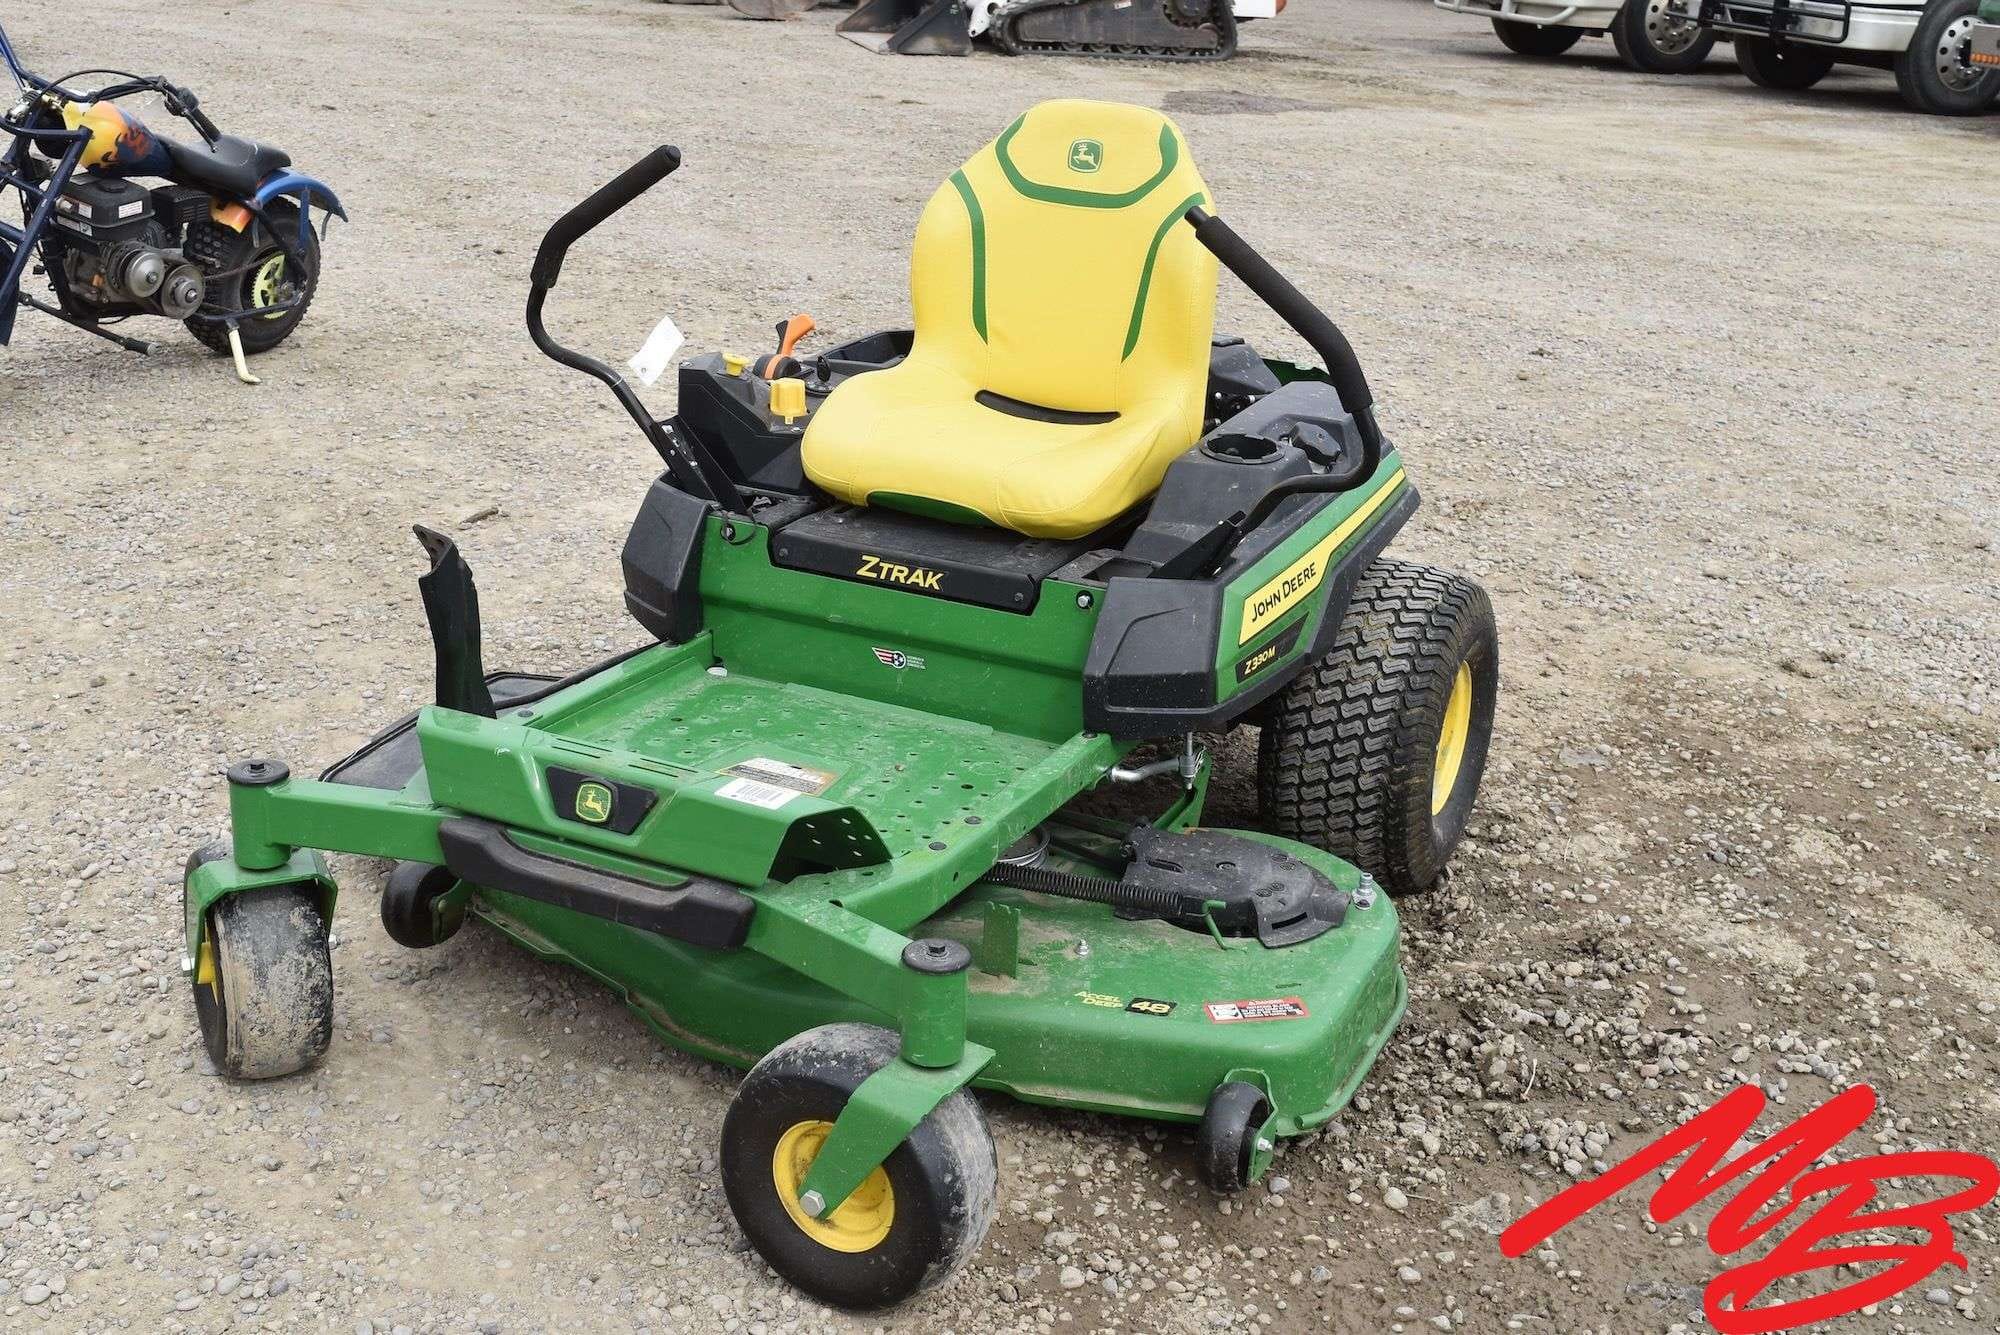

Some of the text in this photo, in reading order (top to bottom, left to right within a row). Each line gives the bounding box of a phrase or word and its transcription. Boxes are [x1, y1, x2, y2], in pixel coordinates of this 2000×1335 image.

[856, 555, 944, 590] ZTRAK
[1252, 562, 1316, 622] JOHN DEERE
[1244, 646, 1276, 675] Z330M
[1131, 1001, 1171, 1013] 48
